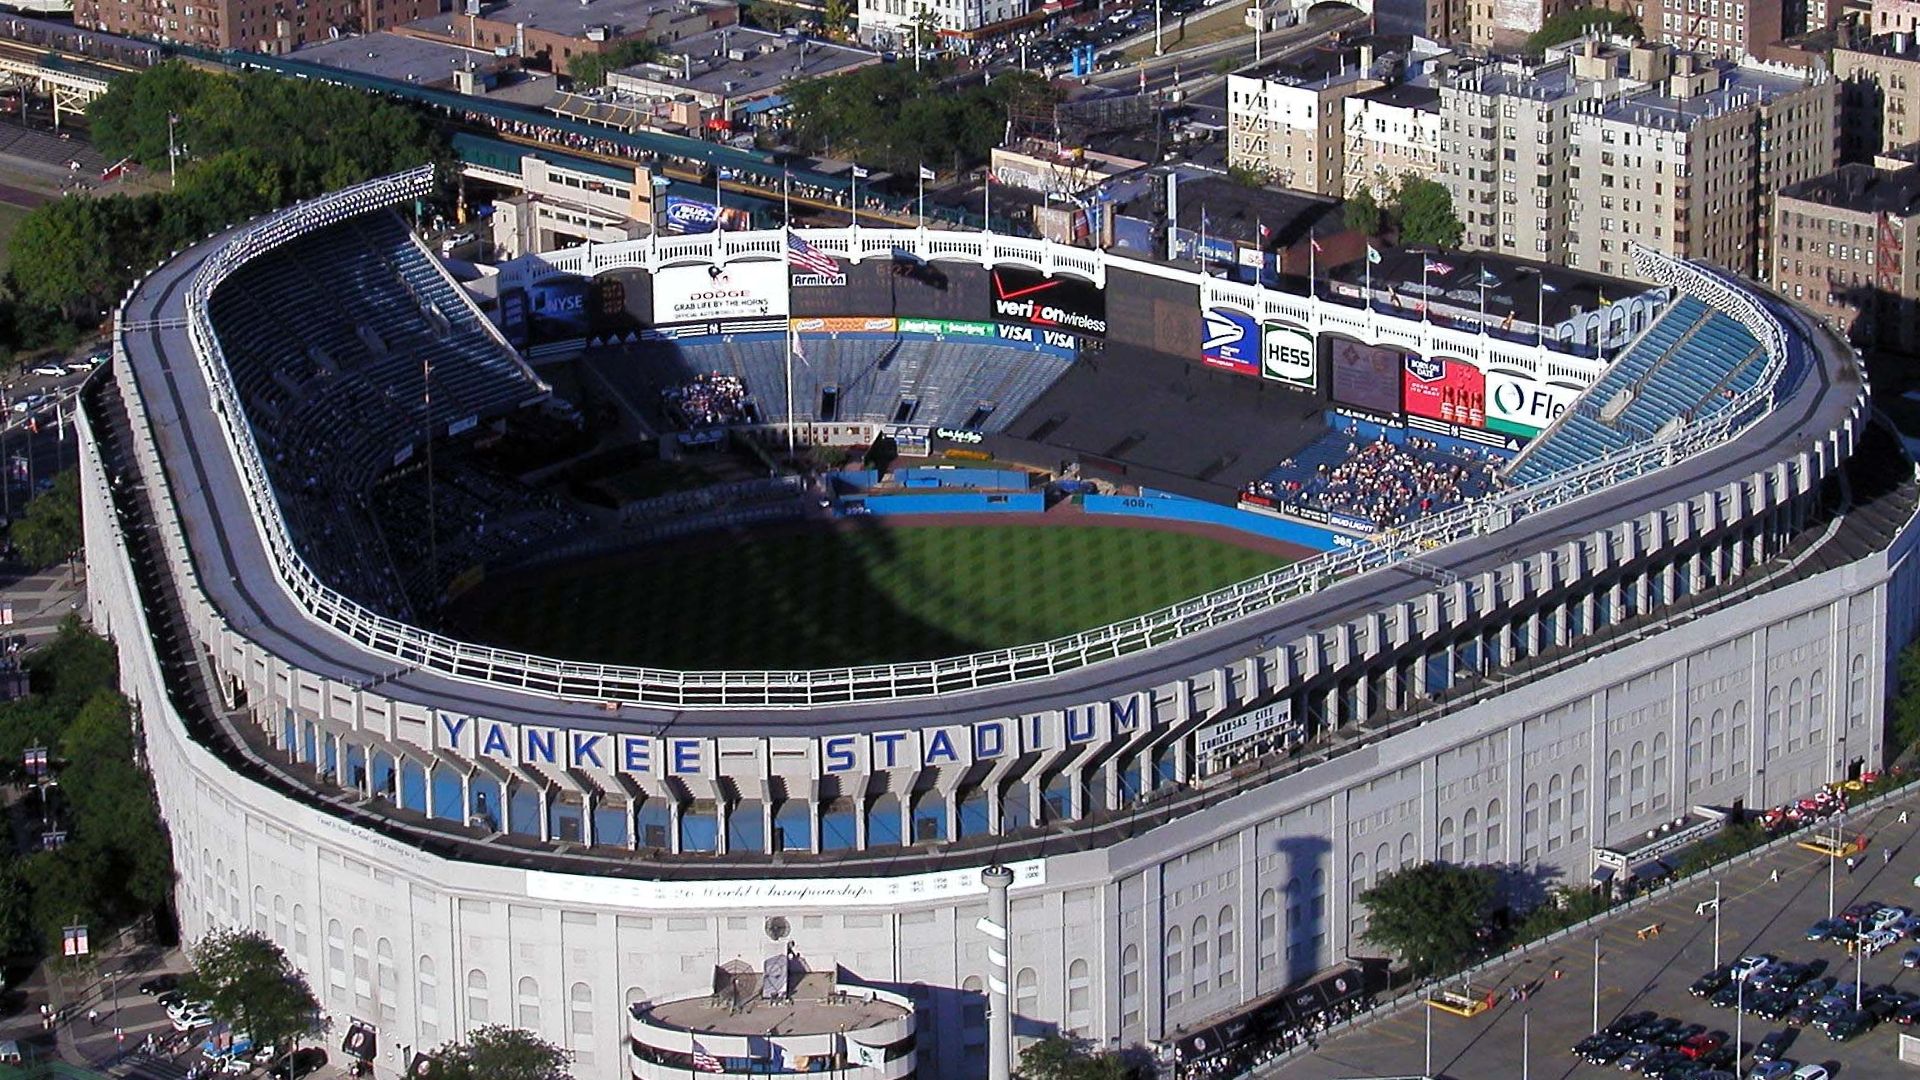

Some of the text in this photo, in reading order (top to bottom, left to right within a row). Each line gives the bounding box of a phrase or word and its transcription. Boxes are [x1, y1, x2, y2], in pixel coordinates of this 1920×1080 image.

[794, 274, 845, 286] Armitron
[550, 295, 583, 312] NYSE
[690, 290, 751, 301] DODGE
[674, 303, 696, 312] GRAB
[996, 299, 1107, 333] verizon wireless
[998, 324, 1033, 342] VISA
[1043, 330, 1075, 350] VISA
[1269, 343, 1310, 367] HESS
[1122, 498, 1145, 508] 408
[1331, 516, 1374, 533] BUD LIGHT
[1216, 706, 1274, 735] KANSAS CITY
[441, 695, 1139, 773] YANKEE STADIUM
[1201, 731, 1234, 752] TONIGHT
[1898, 811, 1907, 824] A
[1771, 869, 1778, 882] A
[703, 886, 751, 898] World
[756, 883, 873, 900] Championships
[1695, 902, 1704, 916] A
